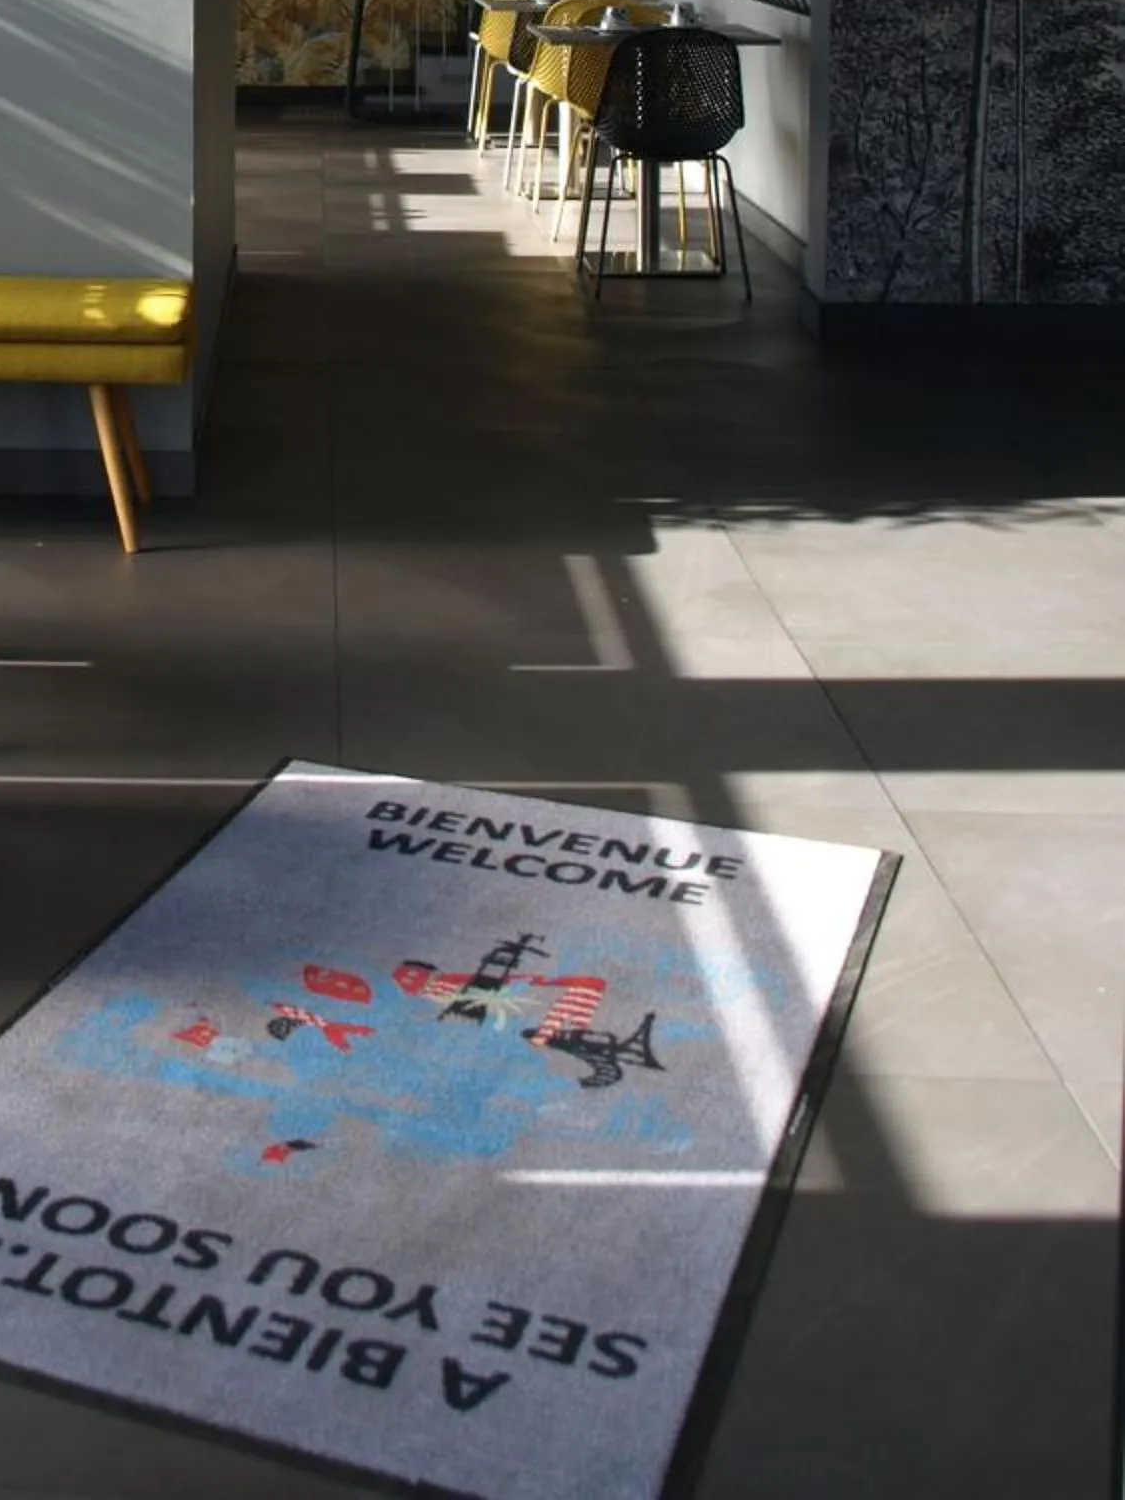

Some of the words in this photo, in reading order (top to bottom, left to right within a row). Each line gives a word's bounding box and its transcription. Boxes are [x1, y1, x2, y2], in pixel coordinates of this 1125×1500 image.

[366, 801, 743, 880] BIENVENUE
[369, 829, 712, 905] WELCOME
[247, 1249, 438, 1331] YOU
[470, 1301, 647, 1379] SEE
[442, 1356, 511, 1412] A
